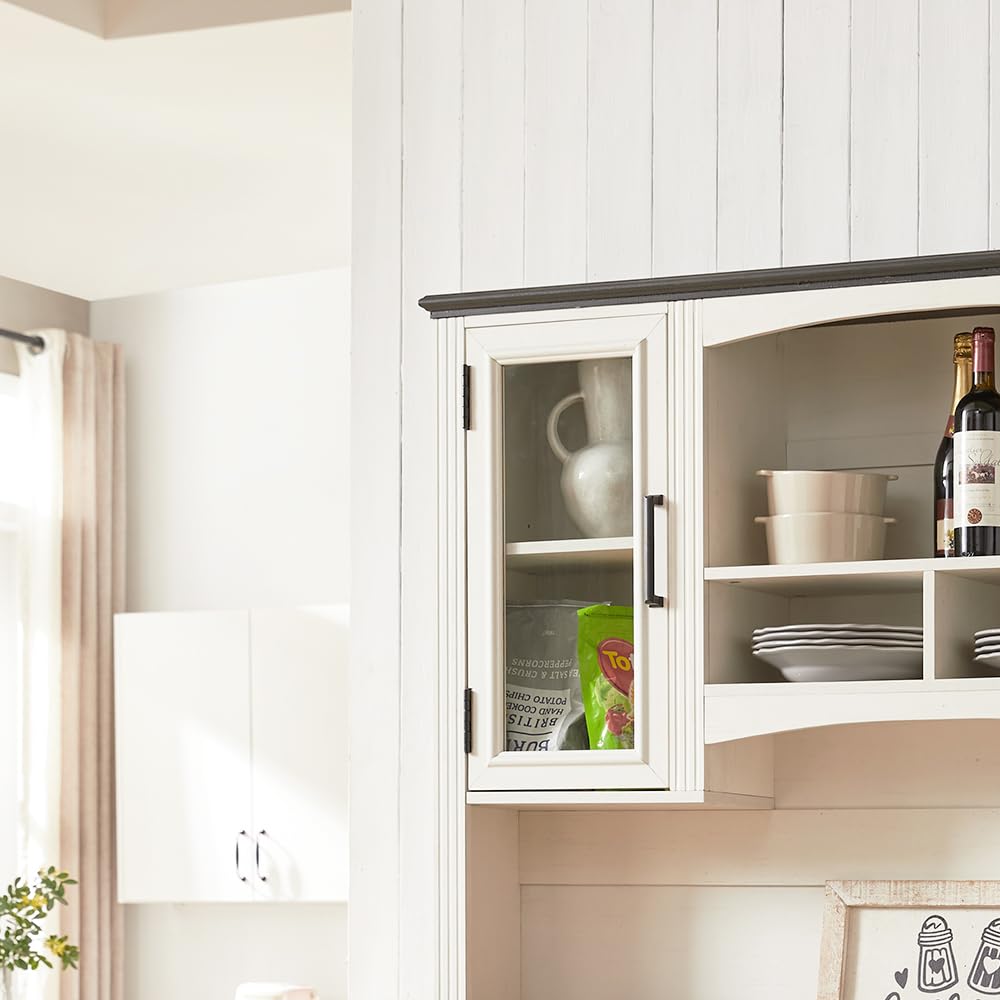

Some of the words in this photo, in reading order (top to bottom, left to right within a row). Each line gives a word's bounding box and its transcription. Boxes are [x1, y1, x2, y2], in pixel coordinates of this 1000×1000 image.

[549, 669, 580, 679] EASALT
[533, 695, 567, 706] POTATO
[539, 707, 564, 716] HAND
[506, 713, 559, 729] BRITIS
